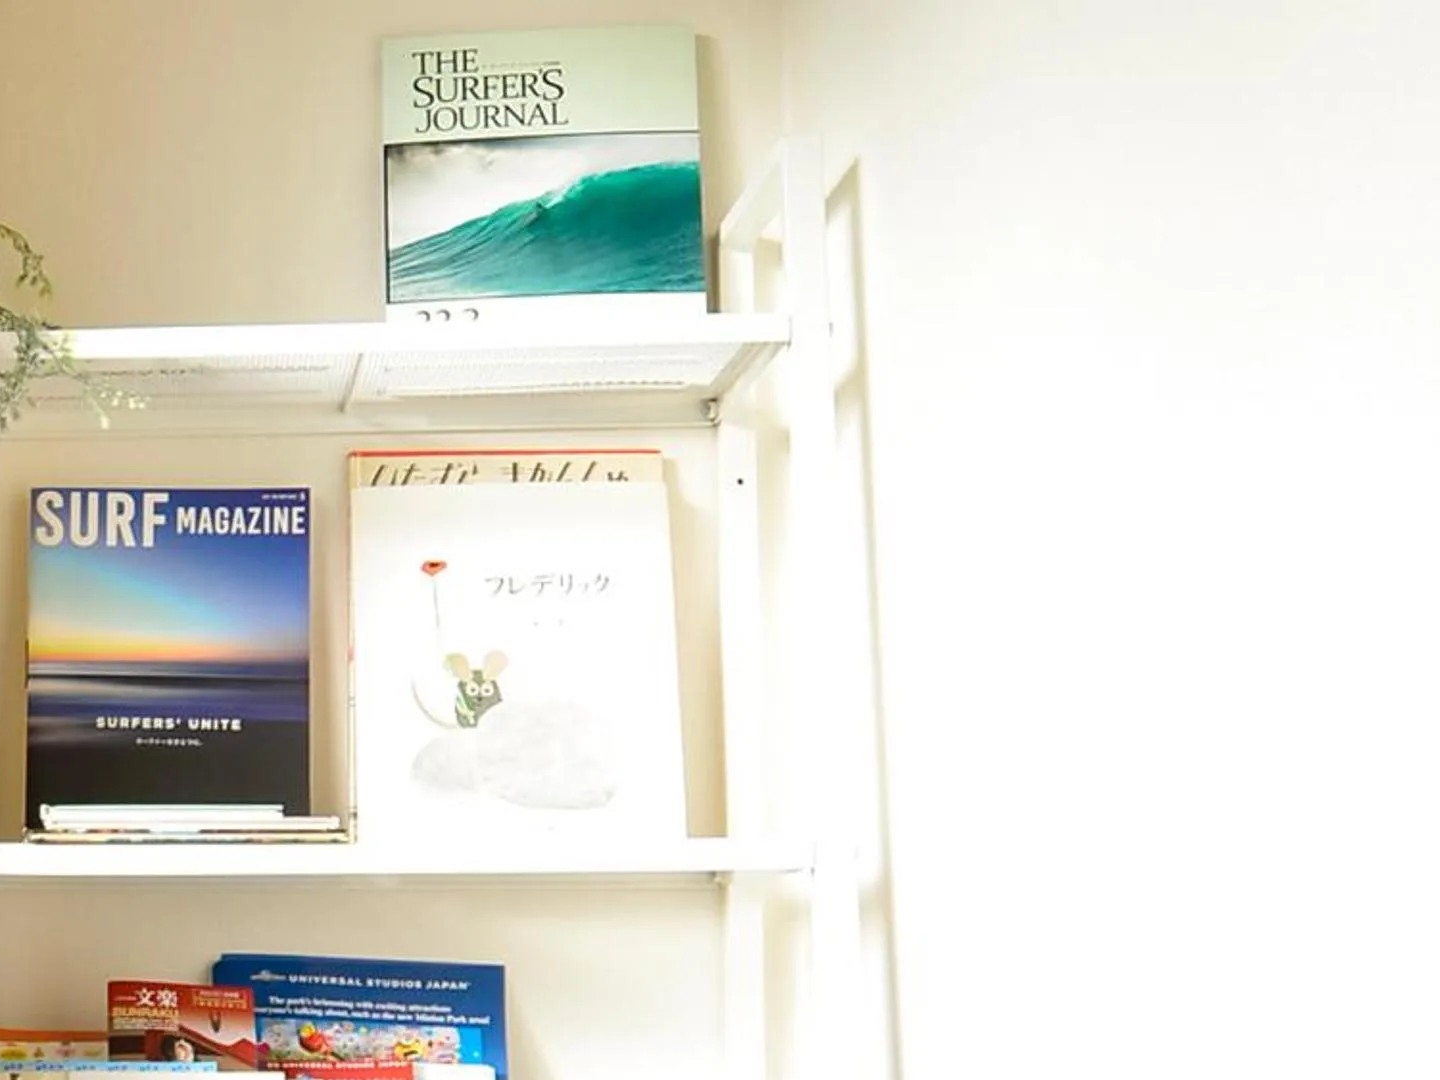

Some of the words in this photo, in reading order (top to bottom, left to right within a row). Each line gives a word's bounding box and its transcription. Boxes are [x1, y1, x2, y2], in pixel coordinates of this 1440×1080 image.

[412, 48, 479, 75] THE
[413, 68, 565, 108] SURFER'S
[415, 103, 569, 133] JOURNAL
[35, 490, 169, 547] SURF
[176, 506, 306, 535] MAGAZINE
[484, 573, 610, 595] フレデリック
[96, 716, 182, 730] SURFERS'
[187, 718, 242, 731] UNITE
[289, 974, 362, 987] UNIVERSAL
[367, 978, 423, 989] STUDIOS
[269, 995, 285, 1005] The
[447, 1014, 468, 1024] Park
